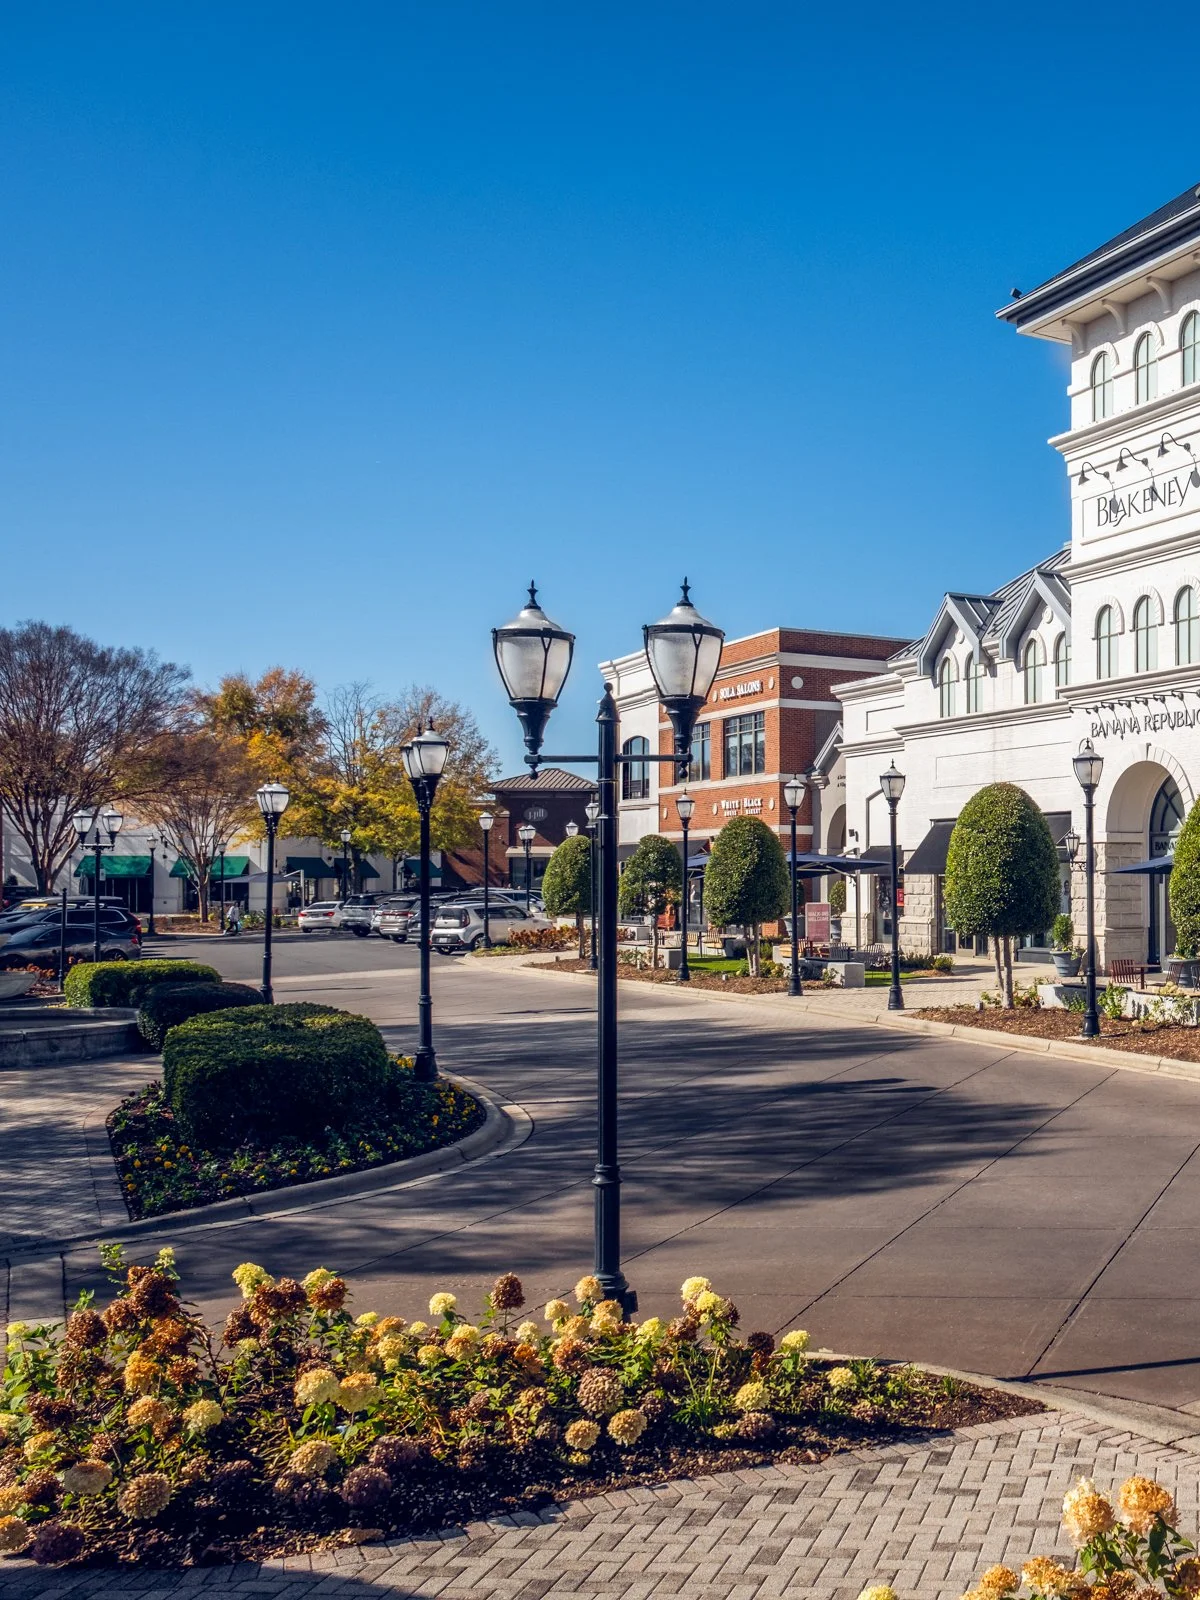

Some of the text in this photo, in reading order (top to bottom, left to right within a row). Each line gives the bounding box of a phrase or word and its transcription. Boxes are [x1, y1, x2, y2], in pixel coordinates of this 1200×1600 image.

[1097, 471, 1193, 527] BLAKENEY
[719, 680, 762, 699] SOLA SALONS
[1091, 717, 1140, 738] BANANA
[721, 798, 762, 809] WHITE BLACK
